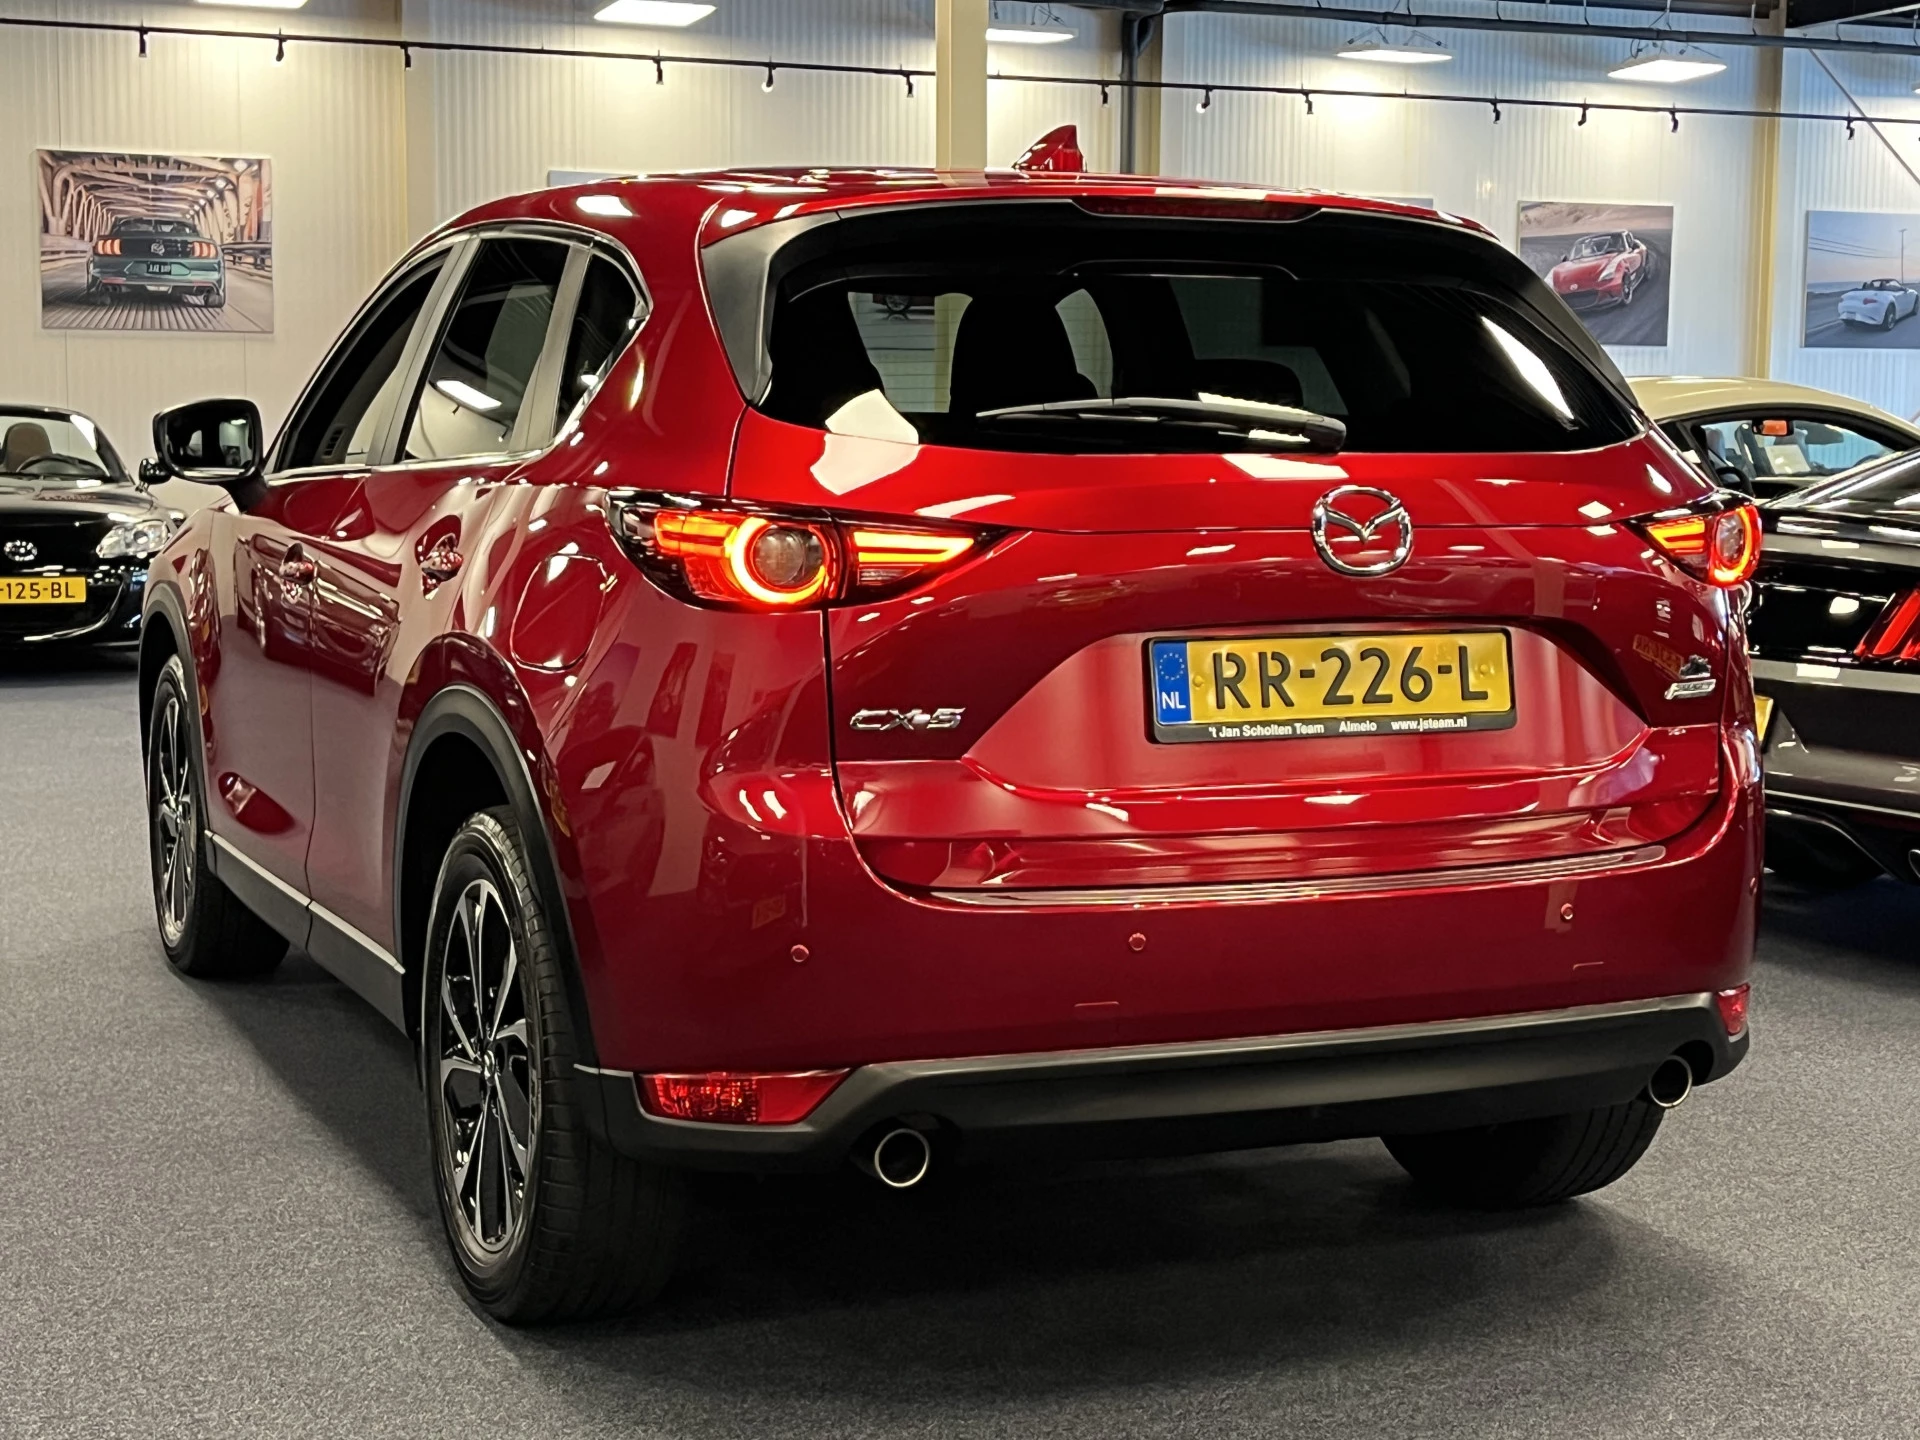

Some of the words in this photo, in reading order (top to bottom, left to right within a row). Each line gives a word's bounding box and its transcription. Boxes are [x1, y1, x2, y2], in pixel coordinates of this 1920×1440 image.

[1212, 646, 1489, 710] RR-226-L
[1161, 691, 1187, 710] NL
[849, 706, 967, 731] CX-5
[1219, 726, 1241, 738] Jan
[1242, 723, 1293, 737] Scholten
[1294, 722, 1325, 735] Team
[1339, 719, 1378, 733] Almelo
[1390, 716, 1468, 732] www.jsteam.nl
